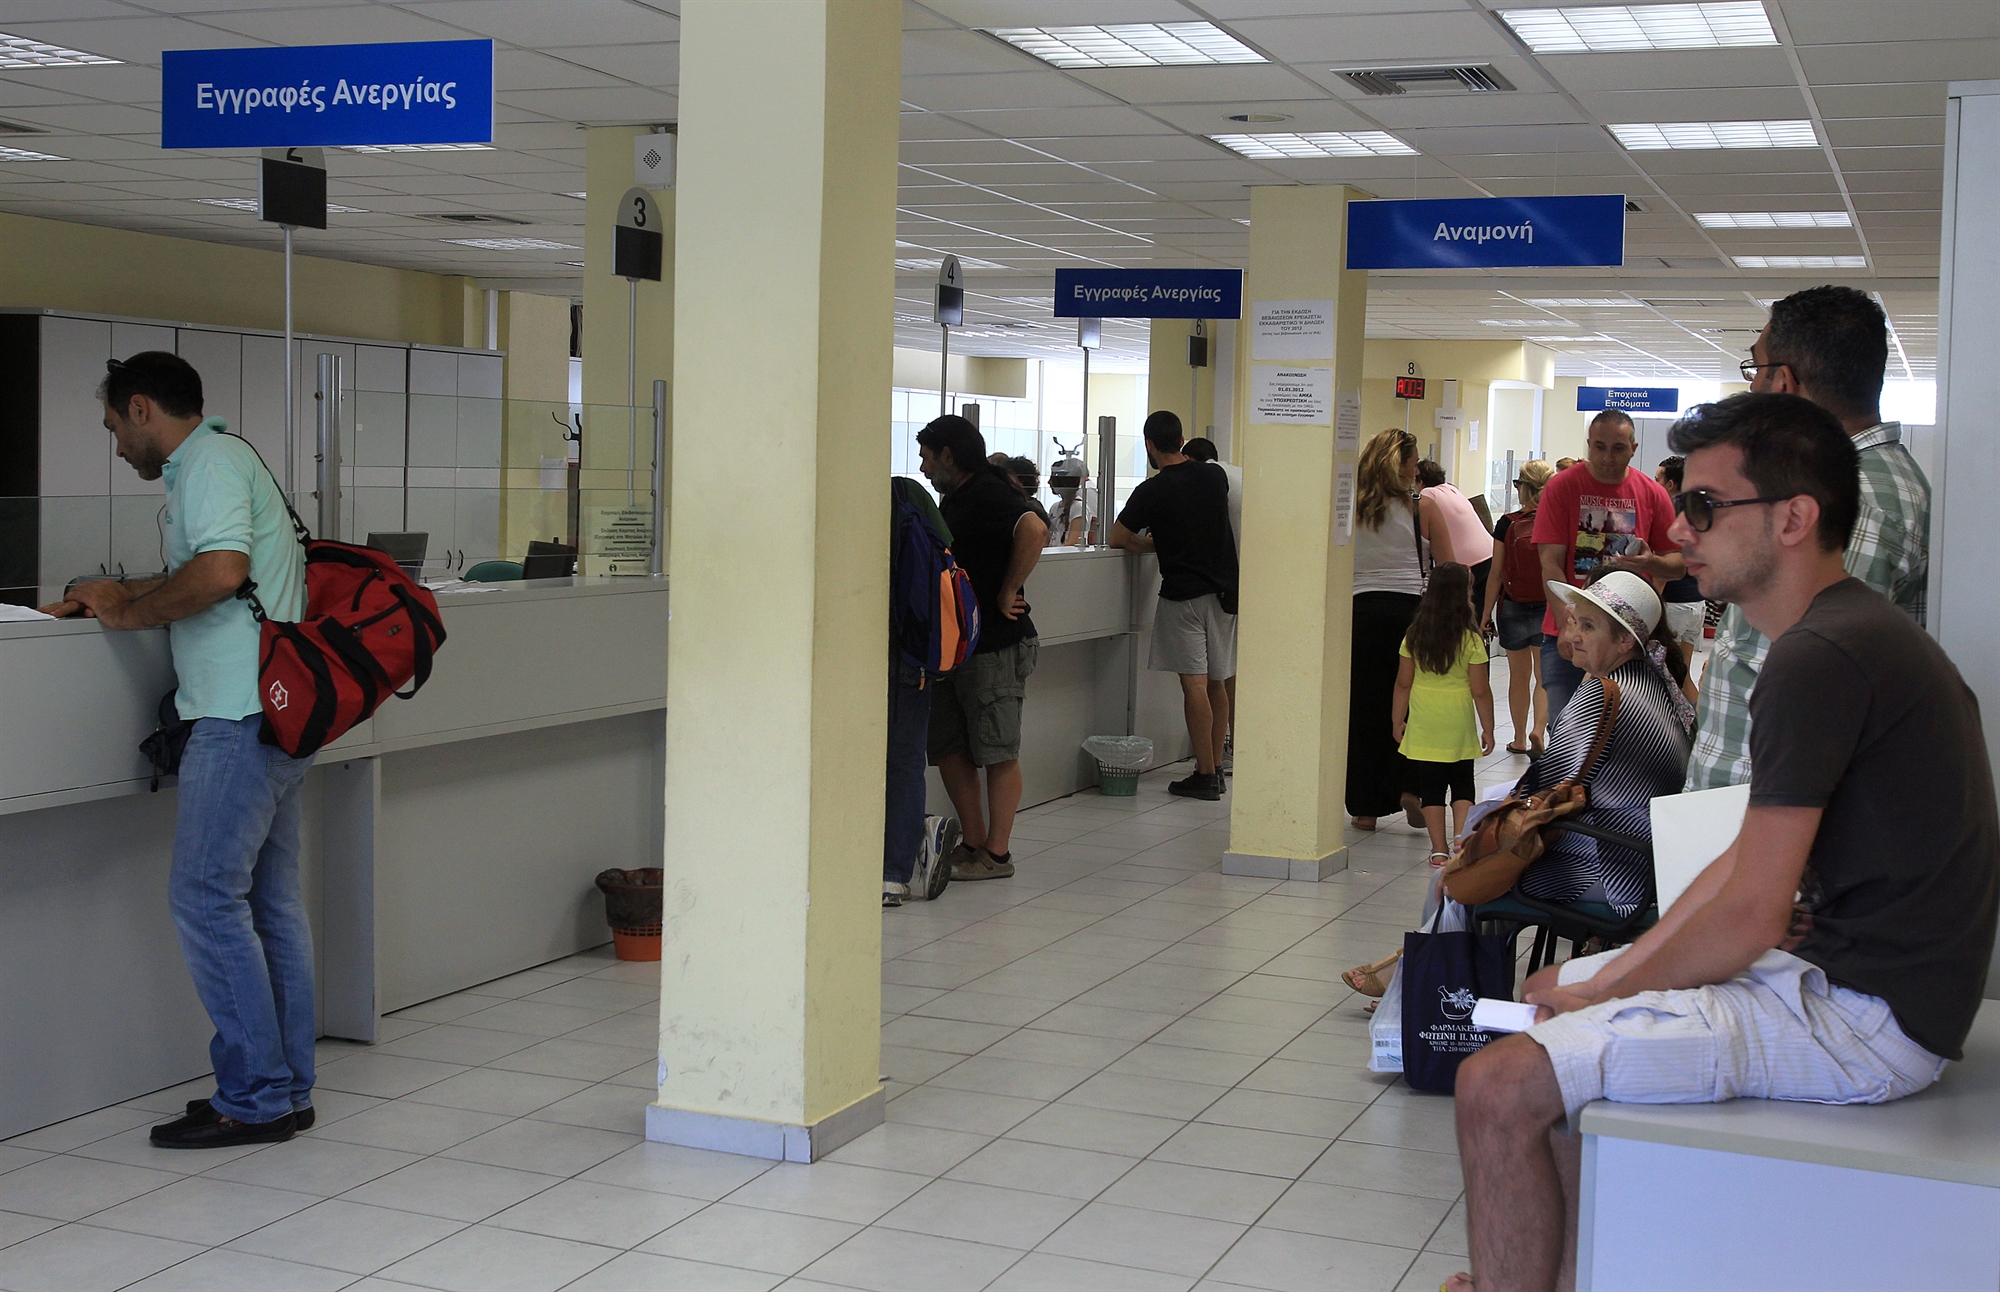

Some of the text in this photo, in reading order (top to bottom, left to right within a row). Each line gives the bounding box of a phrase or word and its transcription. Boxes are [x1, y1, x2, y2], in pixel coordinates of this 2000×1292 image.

[197, 76, 457, 114] Εγγραφές Ανεργίας
[634, 196, 646, 228] 3
[1433, 220, 1534, 244] Αναμονή
[948, 262, 954, 285] 4
[1074, 284, 1222, 302] Εγγραφές Ανεργίας
[1196, 318, 1202, 336] 6
[1408, 362, 1415, 375] 8
[1605, 400, 1650, 408] Επιδόματα
[1608, 390, 1648, 400] Εποχιακά
[1580, 495, 1636, 509] MUSIC FESTIVAL
[1419, 1031, 1456, 1040] ΦΩΤΕΙΝΗ
